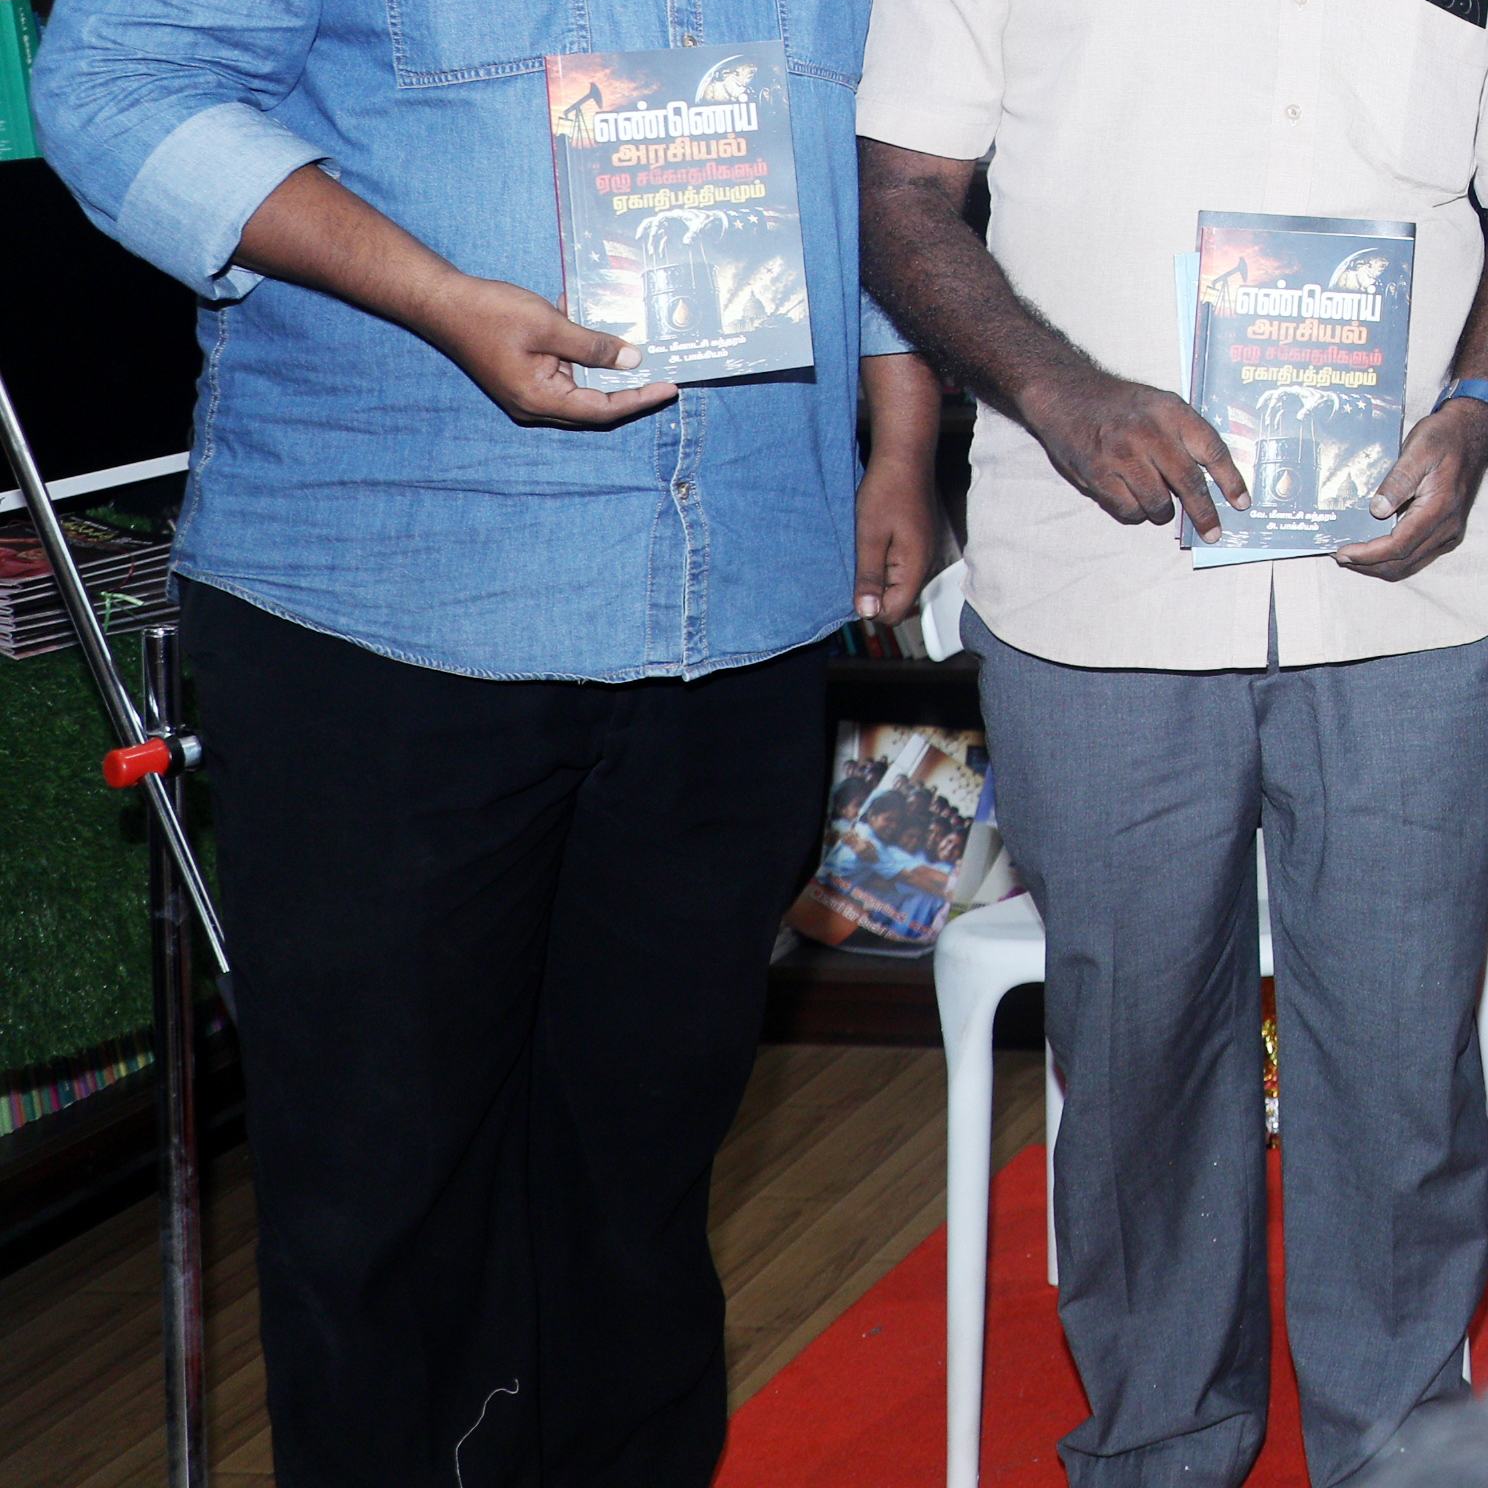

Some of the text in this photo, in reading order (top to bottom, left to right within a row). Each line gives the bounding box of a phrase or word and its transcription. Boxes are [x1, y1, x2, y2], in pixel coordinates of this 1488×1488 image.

[593, 94, 758, 143] எண்ணெய்
[611, 134, 748, 168] அரசியல்
[596, 167, 632, 194] ஏழு
[612, 180, 766, 215] ஏகாதிபத்தியமும்
[1235, 280, 1382, 322] எண்ணெய்
[1247, 318, 1368, 346] அரசியல்
[1229, 345, 1261, 365] ஏழு
[1241, 364, 1377, 387] ஏகாதிபத்தியமும்
